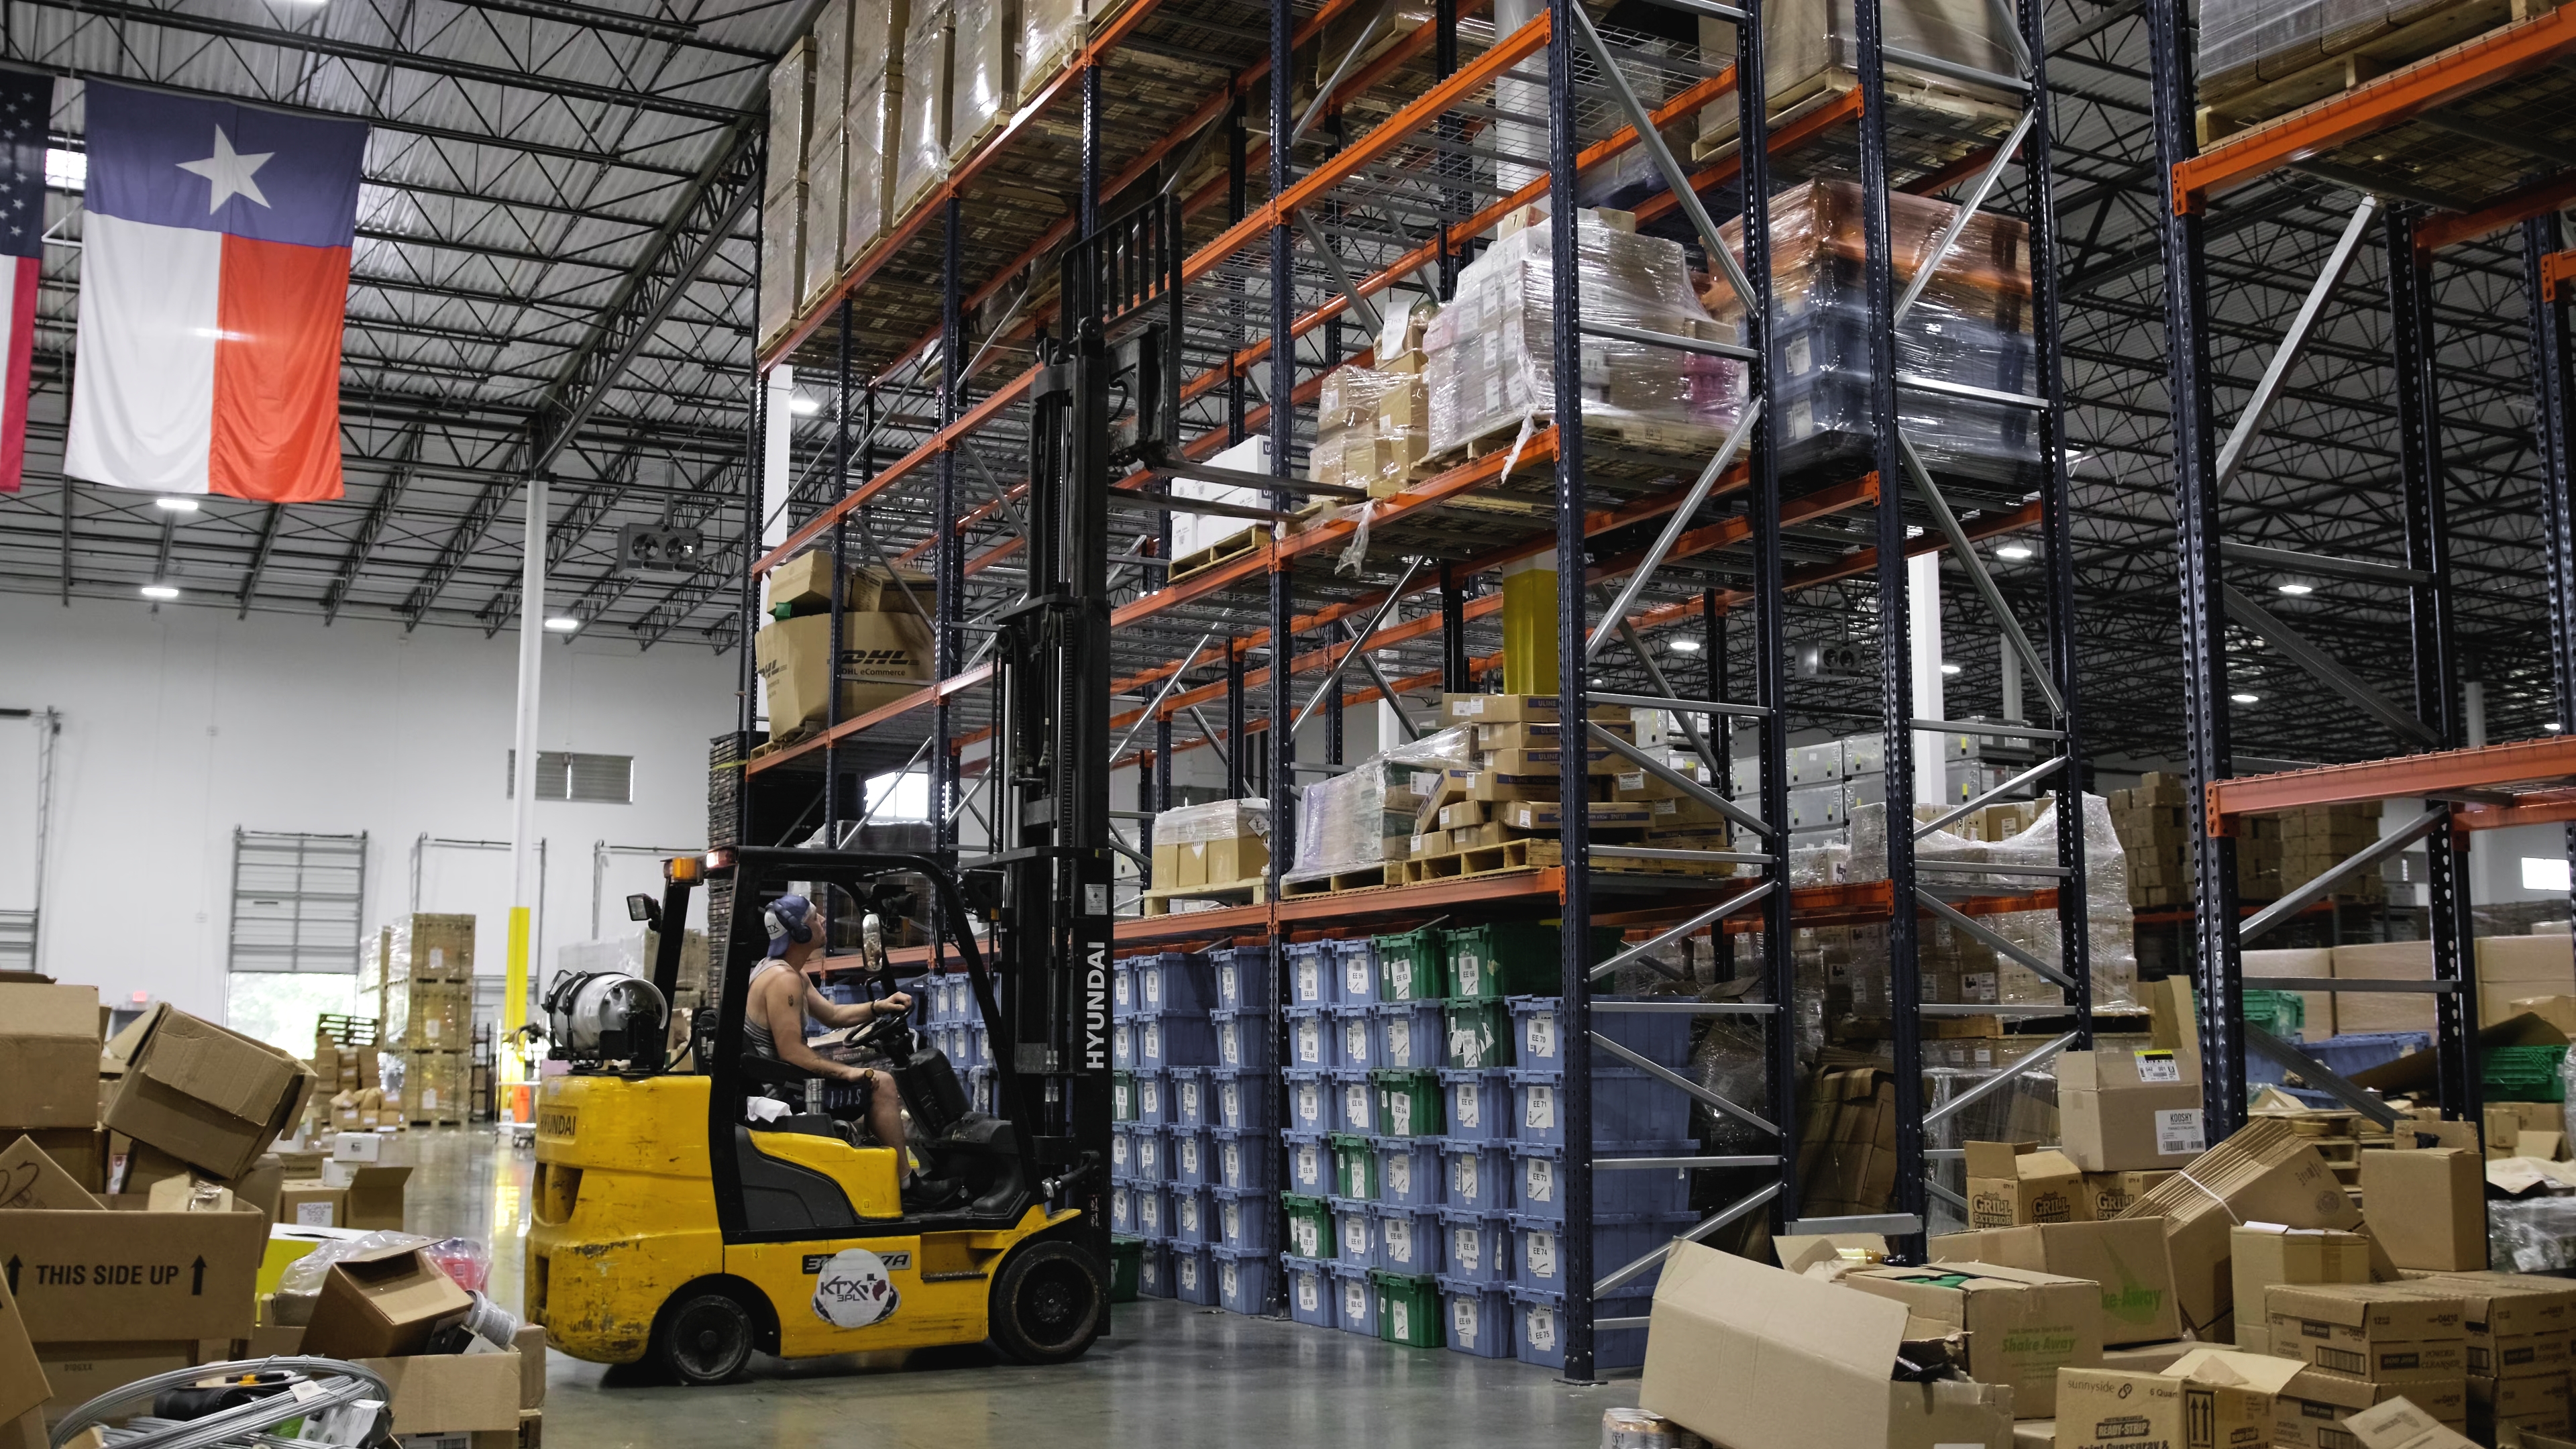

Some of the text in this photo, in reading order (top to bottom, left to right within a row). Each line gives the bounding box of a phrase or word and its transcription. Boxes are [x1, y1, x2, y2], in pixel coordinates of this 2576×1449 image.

[841, 649, 908, 665] DHL
[860, 668, 906, 676] eCommerce
[1086, 942, 1105, 1068] HYUNDAI
[833, 1052, 861, 1061] PREMIUM
[539, 1114, 576, 1136] HYUNDAI
[2169, 1113, 2192, 1122] KOOSHY
[1972, 1195, 2012, 1215] GRILL
[2031, 1195, 2070, 1216] GRILL
[2096, 1191, 2135, 1210] GRILL
[1974, 1214, 2012, 1225] EXTERIOR
[2033, 1212, 2070, 1224] EXTERIOR
[36, 1265, 179, 1285] THIS SIDE UP
[820, 1276, 867, 1300] KTX
[2068, 1380, 2115, 1393] sunnyside
[2149, 1388, 2155, 1396] 6
[2098, 1421, 2147, 1437] READY-STRIP
